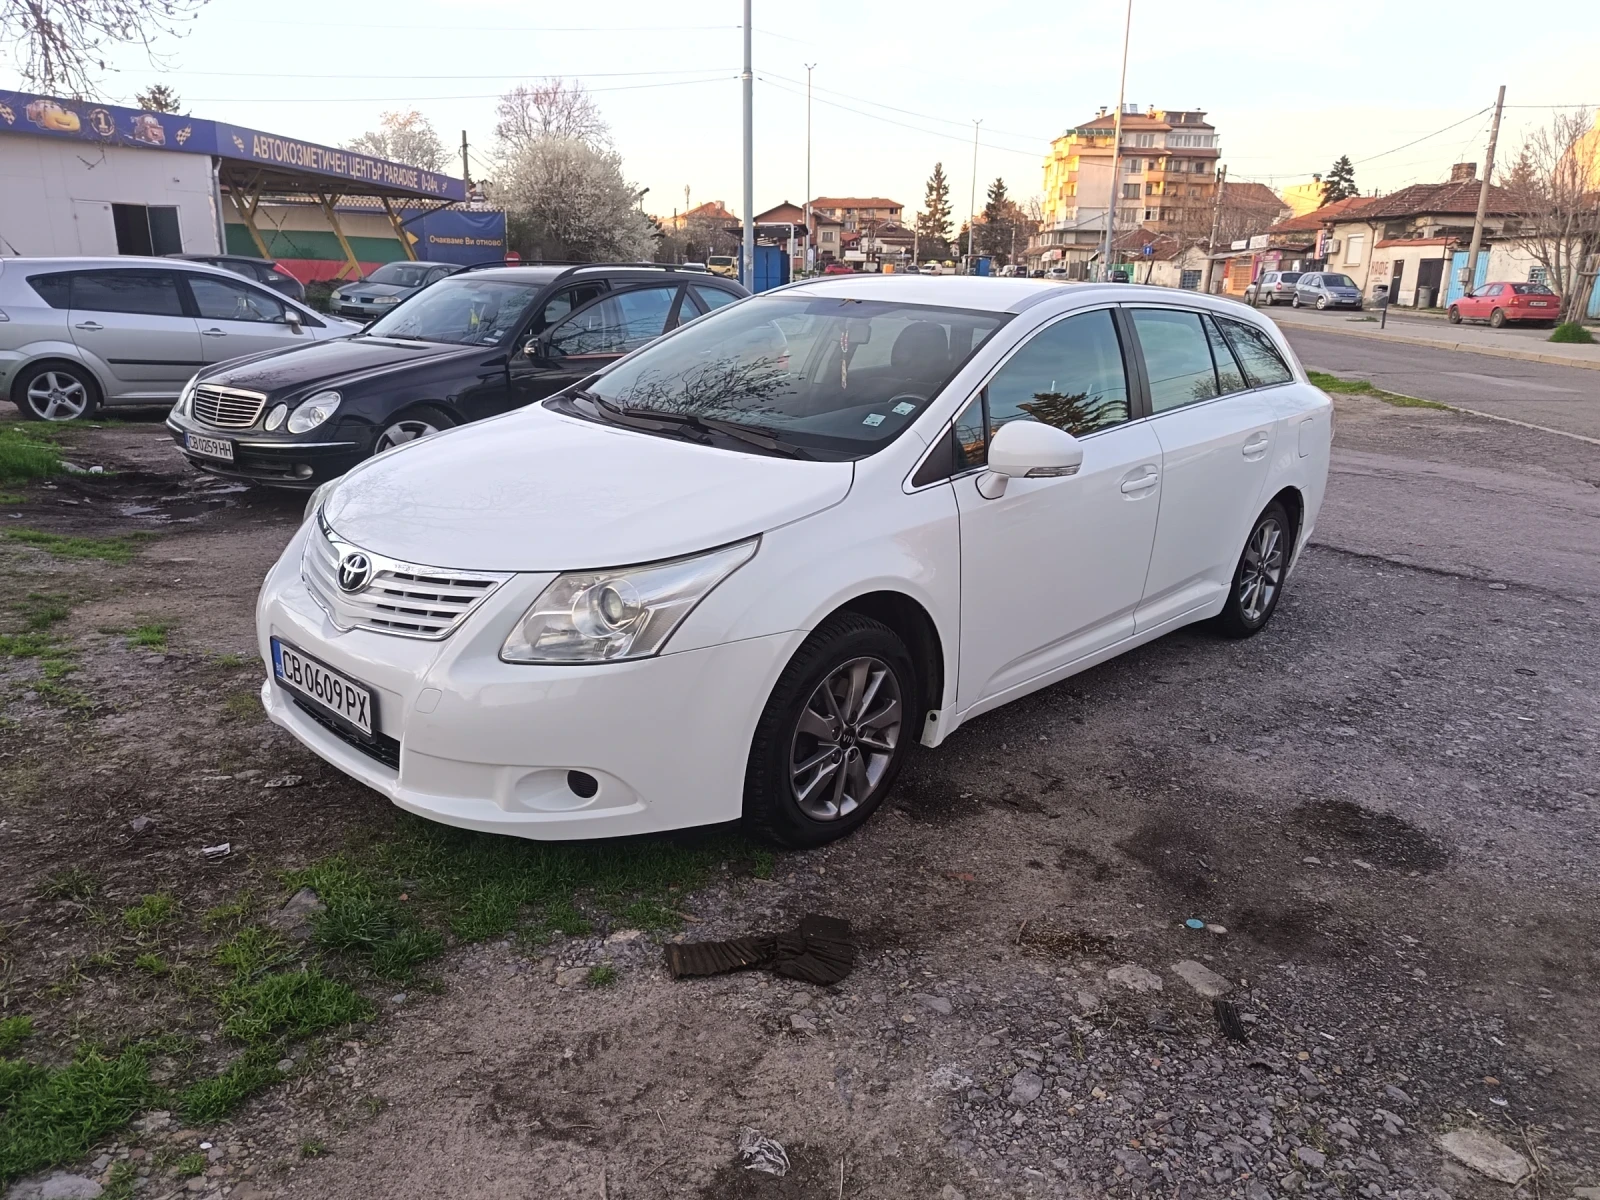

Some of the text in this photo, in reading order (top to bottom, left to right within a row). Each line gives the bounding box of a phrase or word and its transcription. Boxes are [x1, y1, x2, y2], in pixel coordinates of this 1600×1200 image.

[253, 135, 347, 174] АВТОКОЗМЕТИЧЕН
[349, 156, 382, 180] ЦЕНТЪР
[384, 164, 418, 189] PARADISE
[429, 235, 464, 245] Очакваме
[465, 237, 475, 245] Ви
